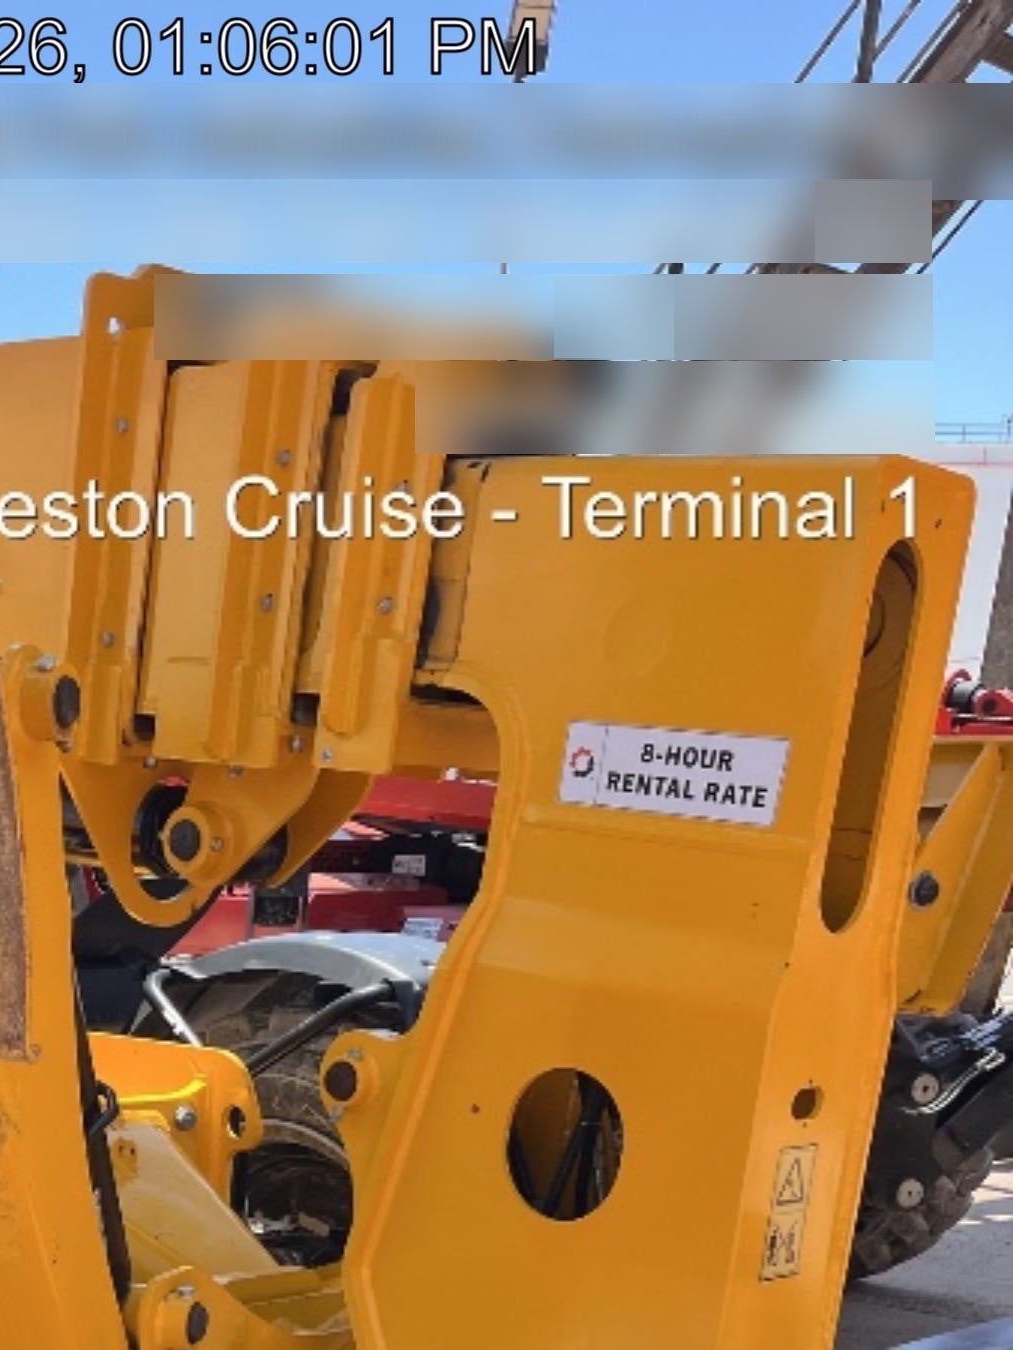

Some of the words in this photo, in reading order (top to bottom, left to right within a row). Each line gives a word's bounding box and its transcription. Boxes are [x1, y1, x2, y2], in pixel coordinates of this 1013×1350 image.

[640, 743, 734, 771] 8-HOUR
[605, 770, 694, 800] RENTAL
[703, 782, 769, 808] RATE
